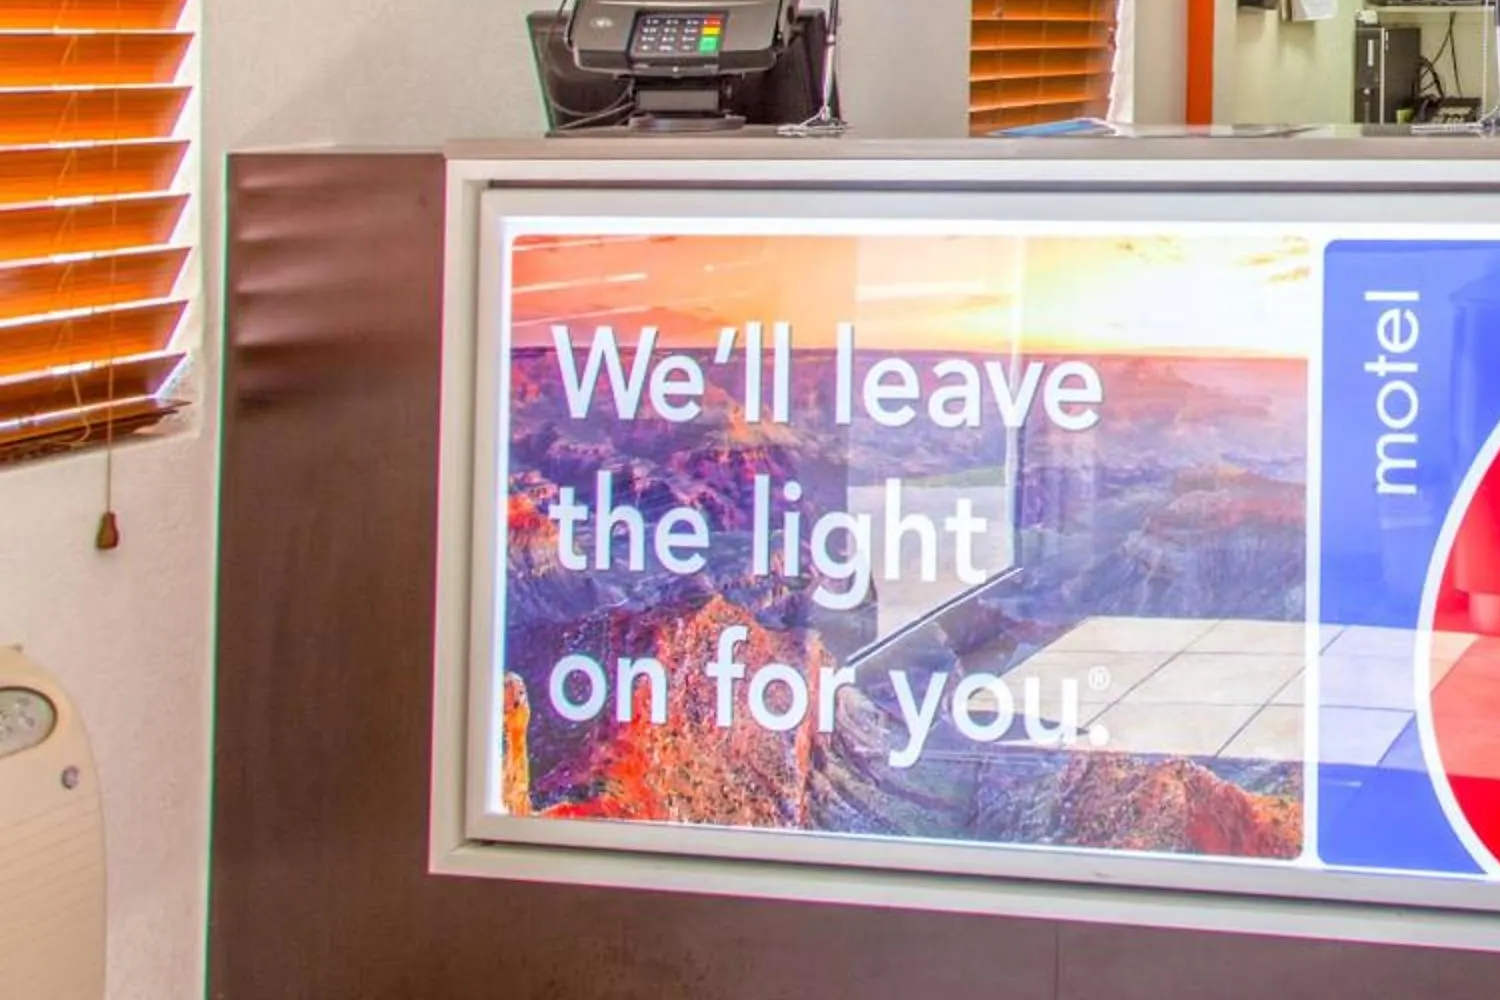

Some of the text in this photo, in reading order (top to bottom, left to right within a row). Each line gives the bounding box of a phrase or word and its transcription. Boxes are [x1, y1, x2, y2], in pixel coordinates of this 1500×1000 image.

[551, 321, 1104, 432] We'll leave
[1363, 289, 1421, 497] motel
[549, 470, 989, 611] the light
[549, 650, 669, 726] on
[705, 625, 855, 734] for
